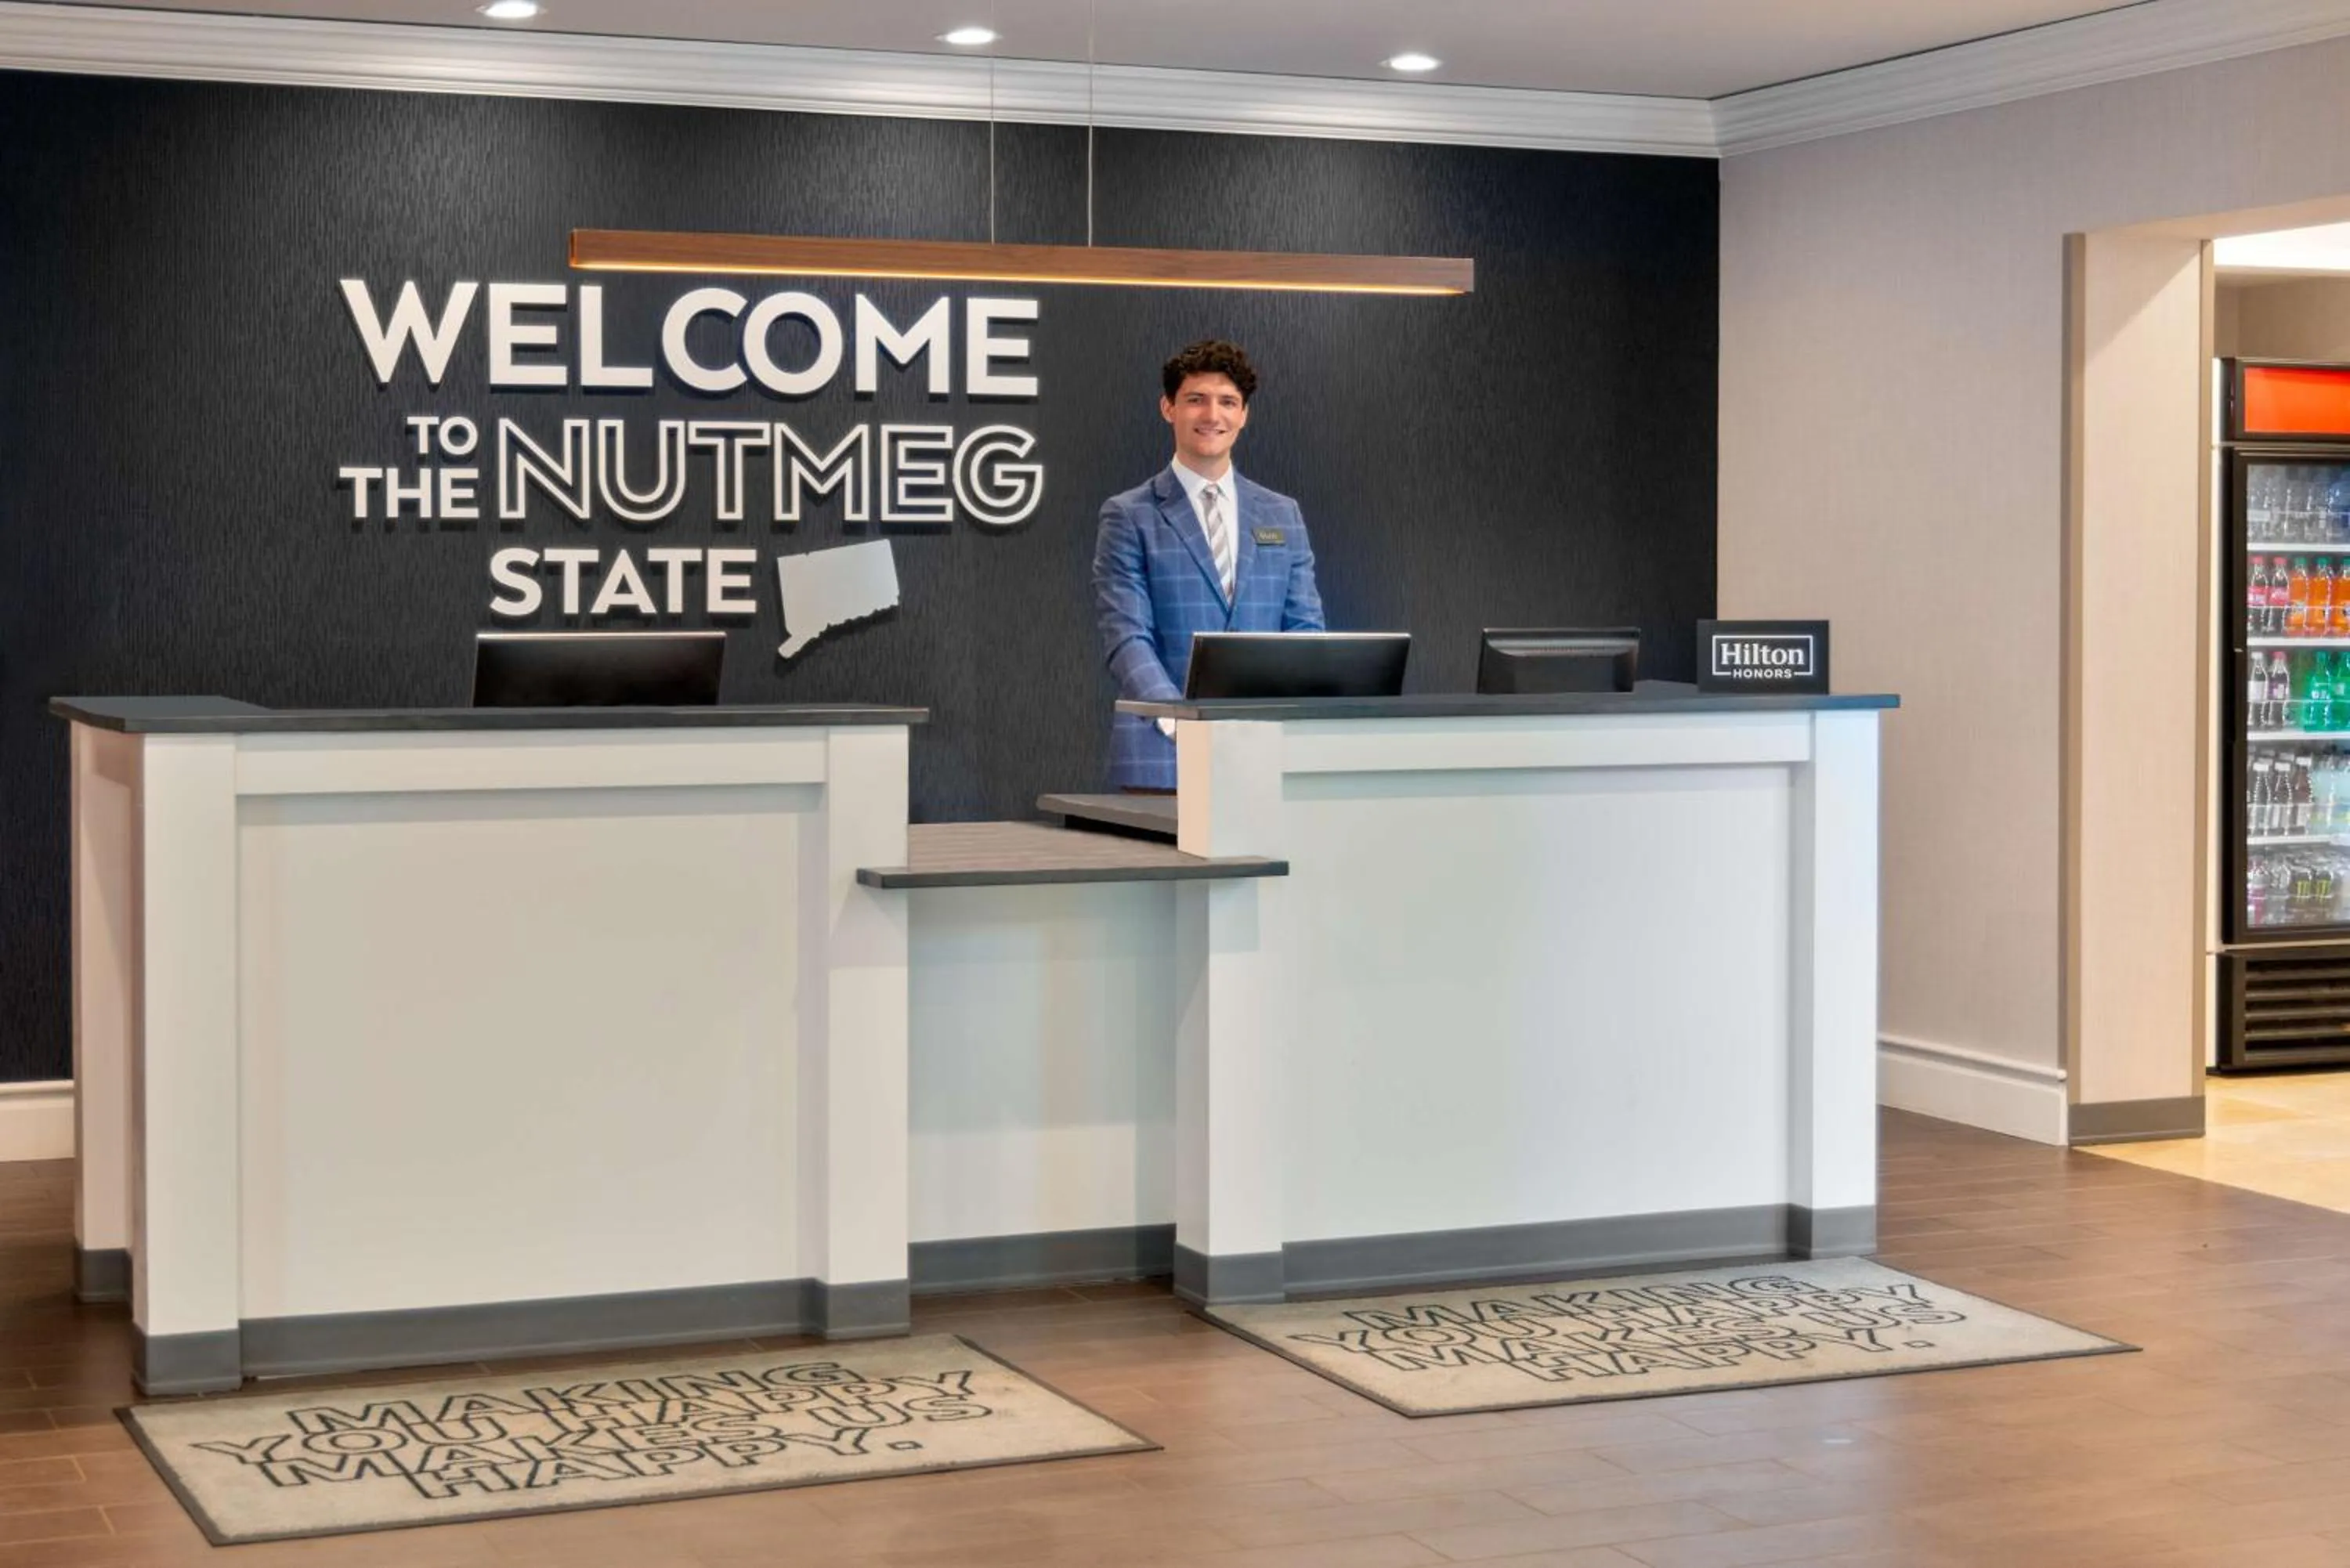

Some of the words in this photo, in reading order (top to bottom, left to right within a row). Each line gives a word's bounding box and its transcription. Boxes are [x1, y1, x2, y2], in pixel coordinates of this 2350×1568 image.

[340, 279, 1039, 396] WELCOME
[407, 416, 477, 456] TO
[339, 468, 479, 518] THE
[498, 418, 1043, 525] NUTMEG
[489, 547, 757, 616] STATE
[1720, 643, 1805, 665] Hilton
[1733, 668, 1792, 679] HONORS
[1287, 1317, 1558, 1353] YOU
[1566, 1284, 1935, 1331] HAPPY
[1343, 1276, 1828, 1330] MAKING
[1366, 1317, 1797, 1371] MAKES
[1799, 1303, 1967, 1330] US
[1503, 1328, 1936, 1382] HAPPY.
[190, 1416, 508, 1465] YOU
[544, 1371, 974, 1433] HAPPY
[286, 1363, 865, 1435] MAKING
[257, 1411, 781, 1487] MAKES
[808, 1394, 994, 1429] US
[402, 1427, 923, 1499] HAPPY.
